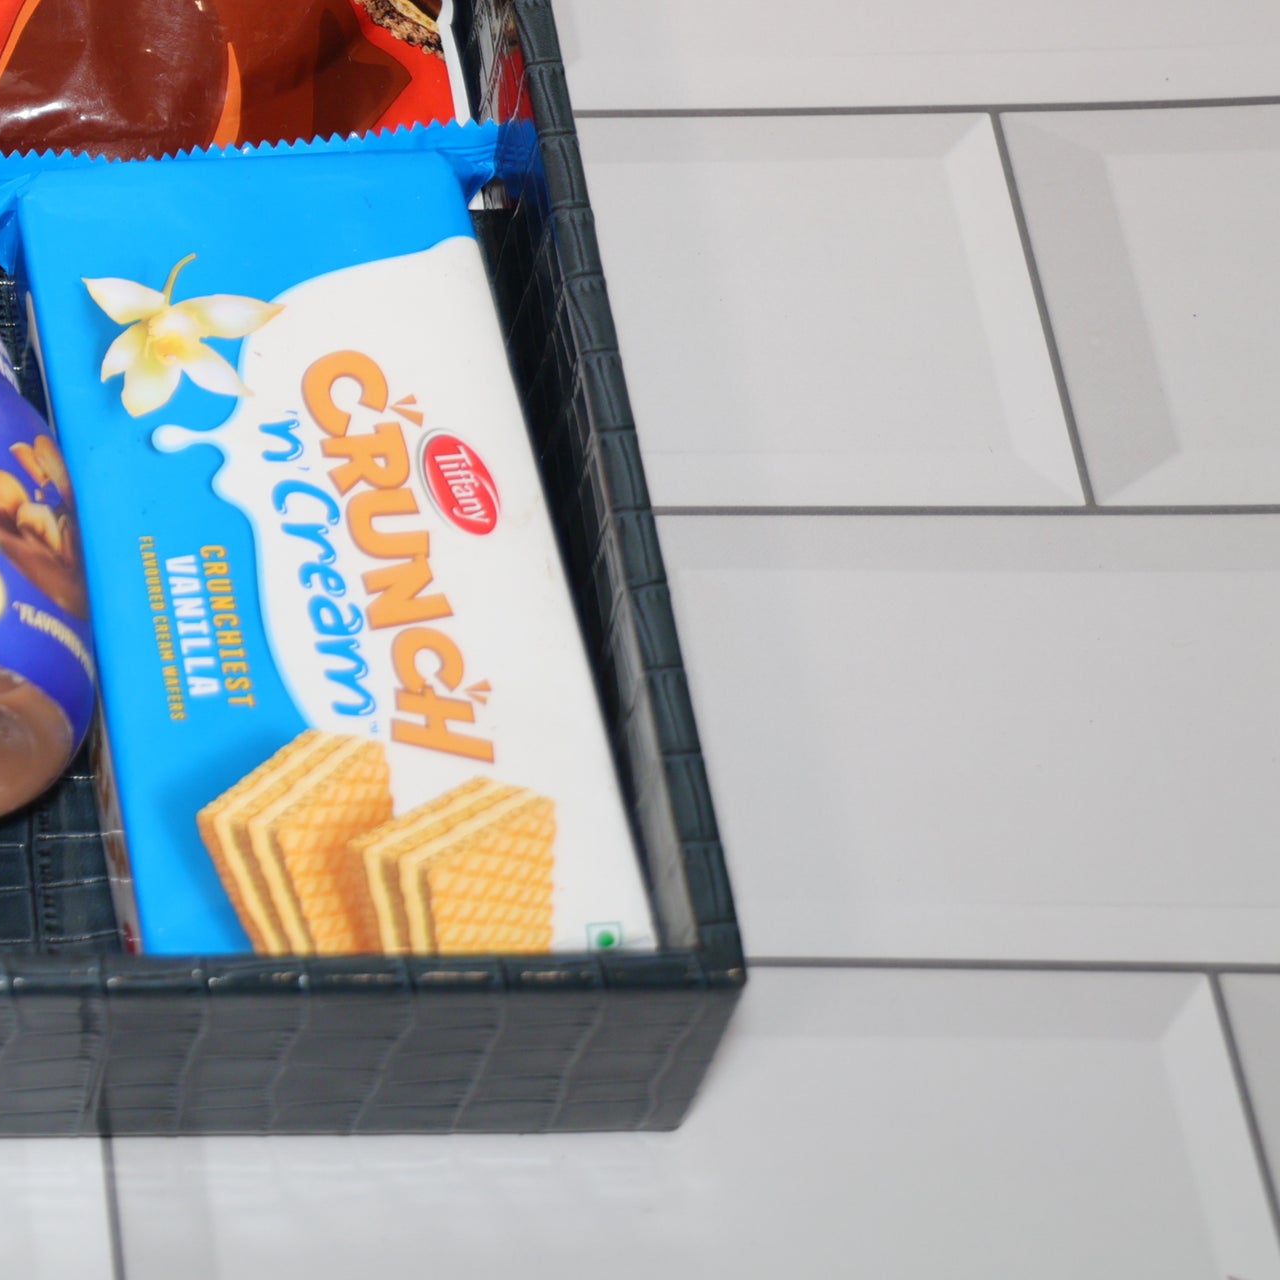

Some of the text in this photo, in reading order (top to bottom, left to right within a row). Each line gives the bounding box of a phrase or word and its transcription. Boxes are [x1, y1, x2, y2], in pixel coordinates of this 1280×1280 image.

[301, 349, 494, 763] CRUNCH
[434, 444, 490, 524] Tiffany
[138, 535, 187, 720] FLAVOURED CREAM WAFERS
[165, 554, 220, 696] VANILLA
[200, 544, 256, 707] CRUNCHIEST
[272, 479, 377, 716] Cream
